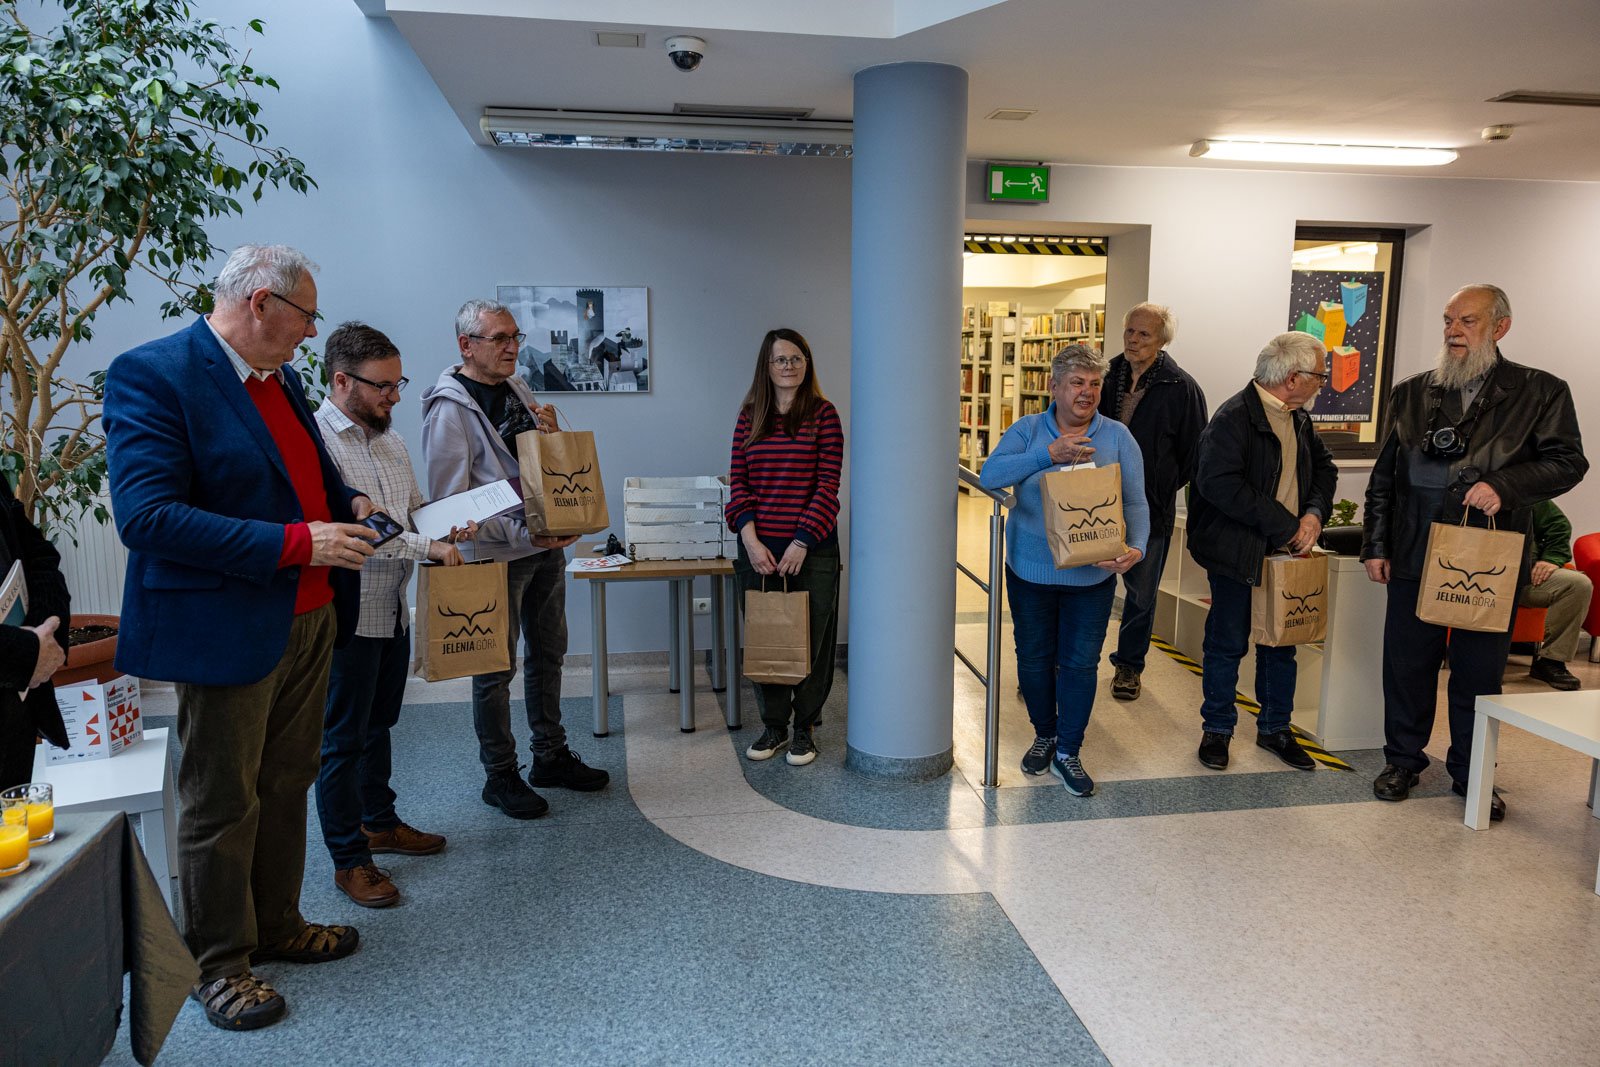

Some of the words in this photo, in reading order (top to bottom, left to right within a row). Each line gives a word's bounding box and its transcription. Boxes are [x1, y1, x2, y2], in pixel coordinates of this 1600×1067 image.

[554, 497, 579, 507] JELENIA
[579, 496, 597, 506] GÓRA
[1068, 530, 1099, 543] JELENIA
[1099, 527, 1121, 540] GÓRA
[1436, 591, 1470, 605] JELENIA
[1472, 596, 1496, 608] GÓRA
[1284, 617, 1304, 629] JELENIA
[442, 641, 475, 655] JELENIA
[476, 638, 498, 651] GÓRA
